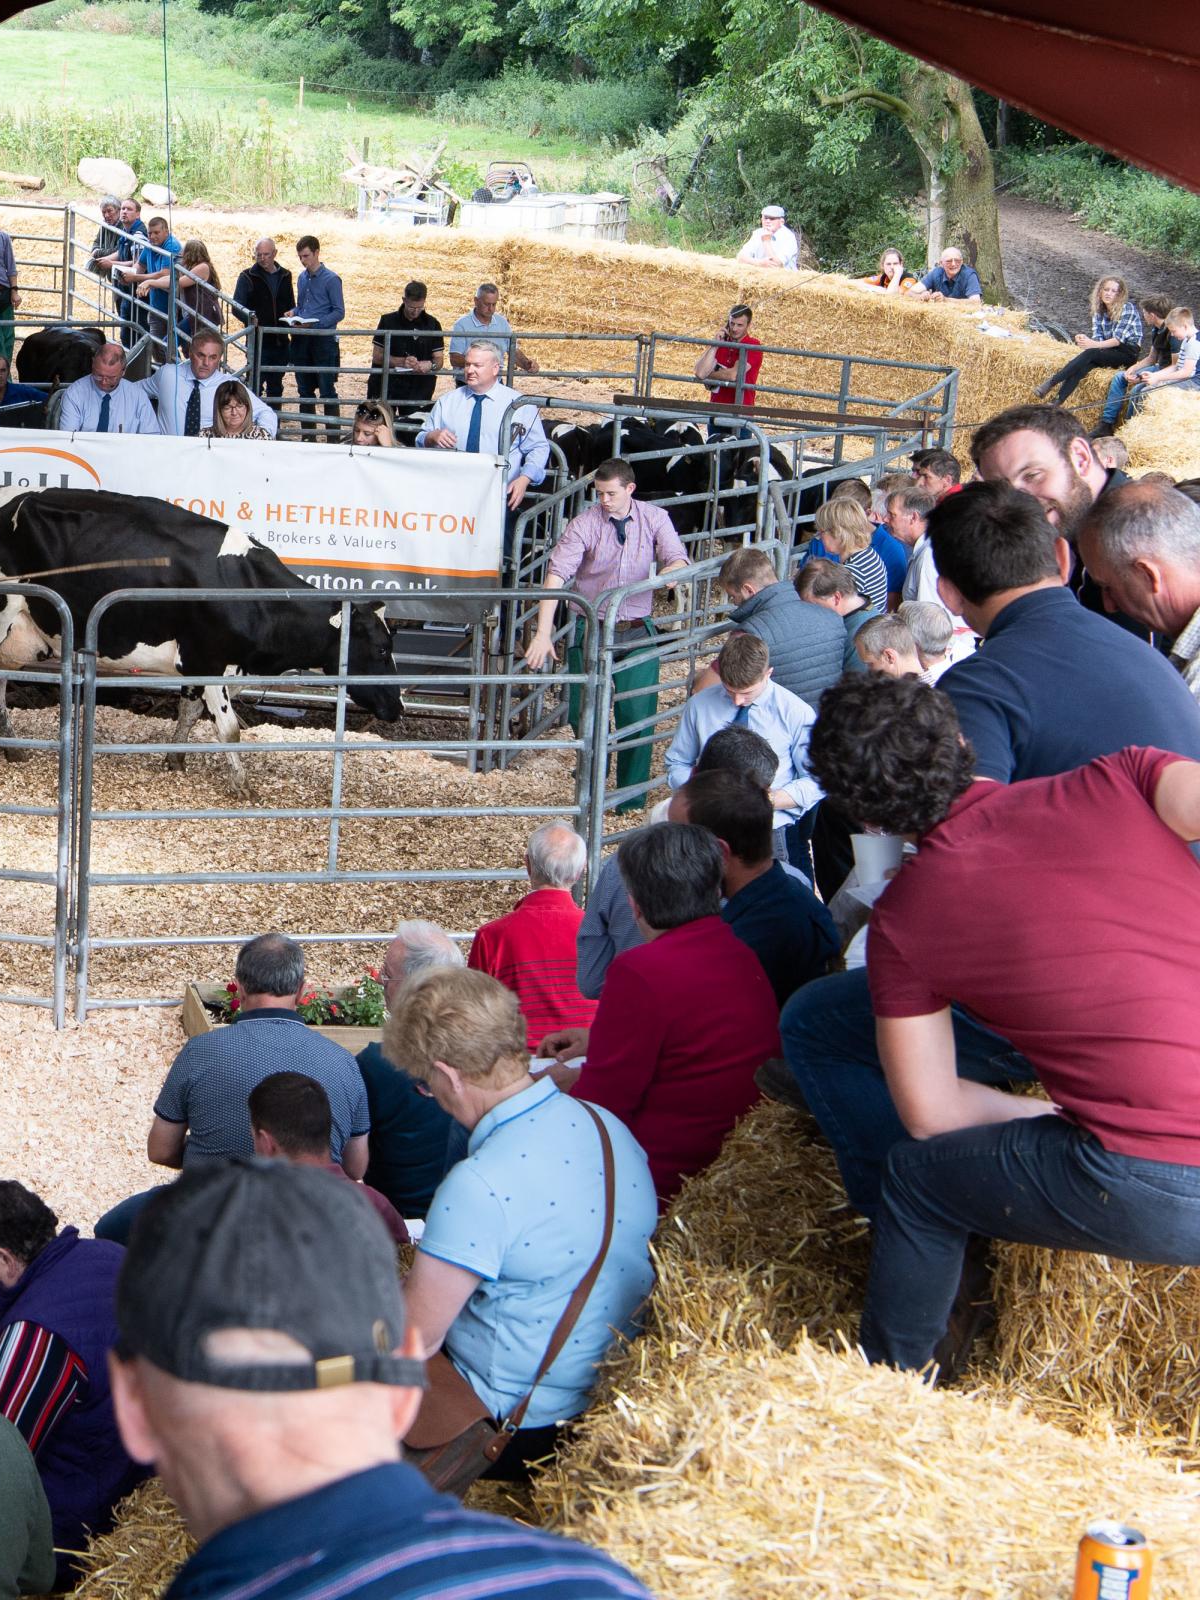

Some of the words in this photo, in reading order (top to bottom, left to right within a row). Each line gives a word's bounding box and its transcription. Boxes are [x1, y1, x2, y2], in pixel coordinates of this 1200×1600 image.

[237, 501, 253, 521] &
[266, 503, 476, 535] HETHERINGTON
[267, 530, 321, 545] Brokers
[328, 533, 337, 546] &
[343, 534, 397, 550] Valuers
